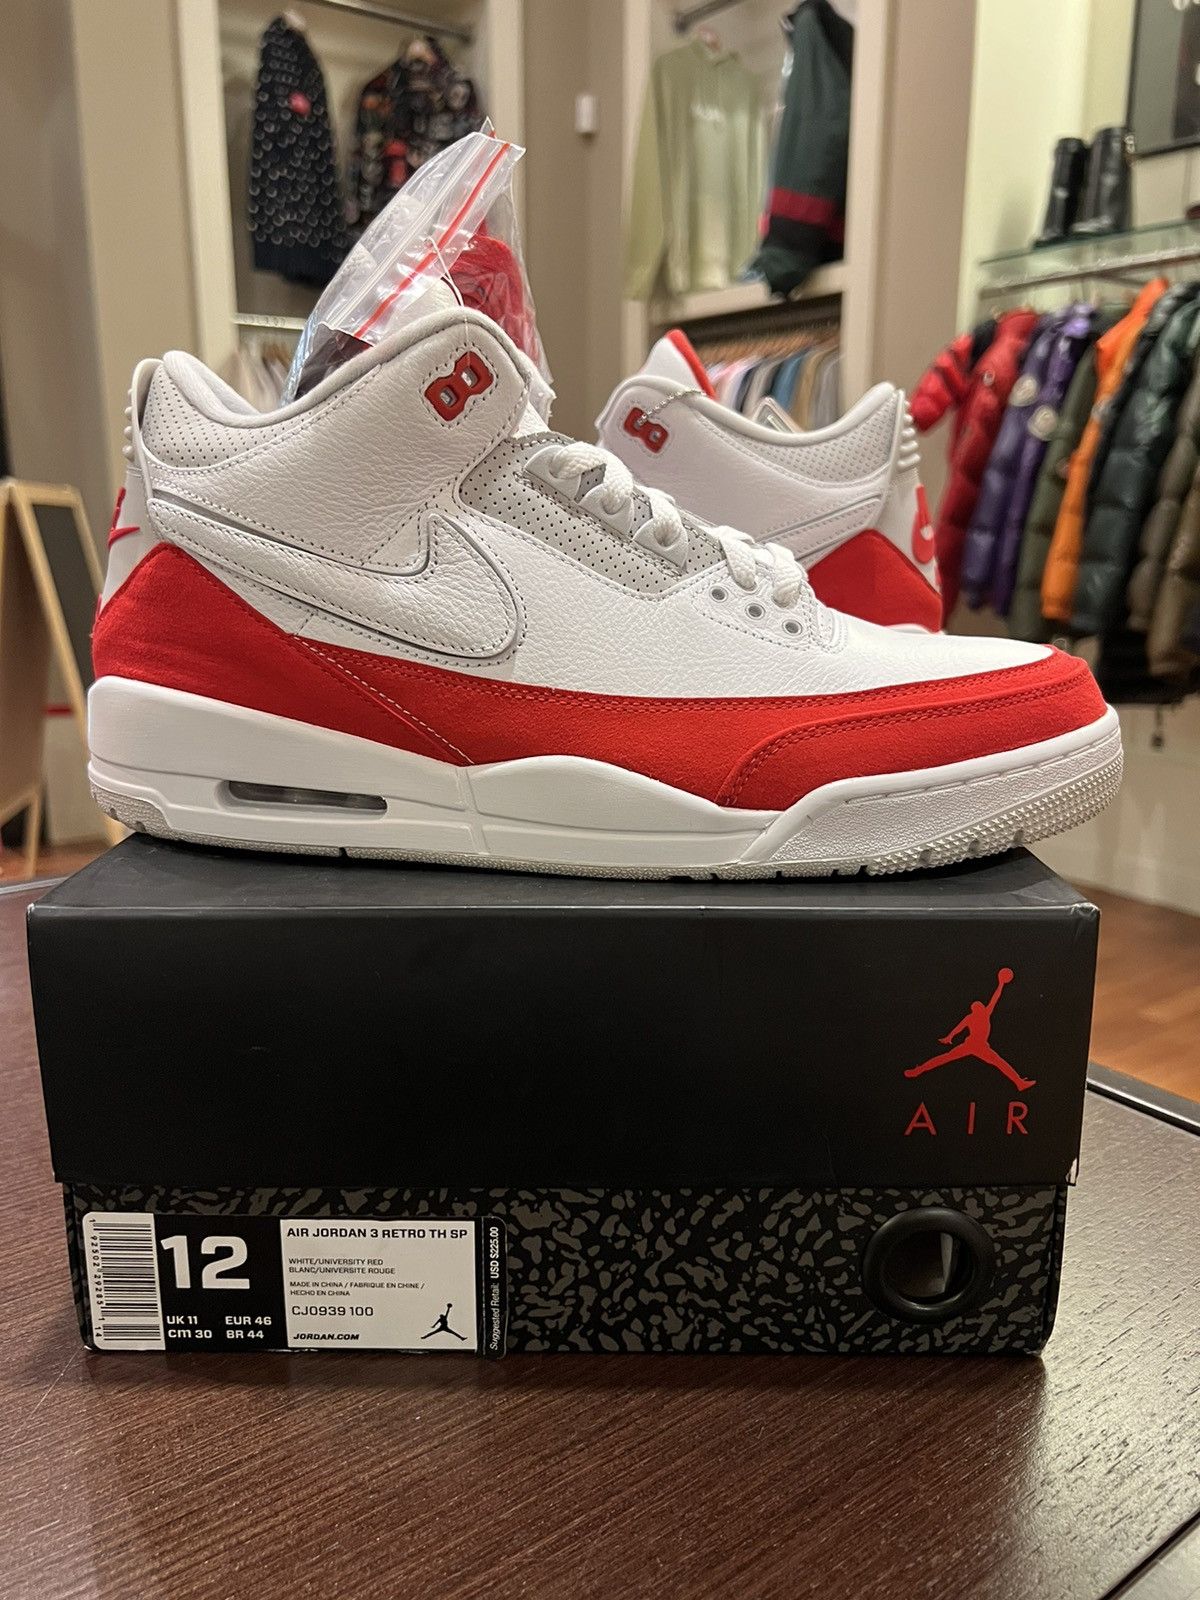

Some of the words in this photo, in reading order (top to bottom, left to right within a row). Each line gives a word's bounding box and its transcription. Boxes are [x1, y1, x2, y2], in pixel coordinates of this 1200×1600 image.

[904, 1101, 1029, 1136] AIR
[287, 1227, 310, 1238] AIR
[312, 1227, 367, 1238] JORDAN
[370, 1228, 379, 1238] 3
[382, 1228, 426, 1239] RETRO
[429, 1228, 447, 1239] TH
[450, 1229, 468, 1239] SP
[490, 1226, 499, 1259] $225.00
[91, 1235, 100, 1267] 92502
[160, 1235, 250, 1290] 12
[288, 1257, 366, 1266] WHITE/UNIVERSITY
[367, 1258, 384, 1266] RED
[288, 1266, 366, 1275] BLANC/UNIVERSITE
[367, 1267, 396, 1275] ROUGE
[490, 1260, 500, 1279] USD
[94, 1274, 104, 1306] 29285
[349, 1281, 385, 1289] FABRIQUE
[397, 1282, 419, 1290] CHINE
[291, 1305, 346, 1316] CJ0939
[349, 1306, 374, 1317] 100
[166, 1315, 185, 1325] UK
[187, 1315, 198, 1325] 11
[225, 1316, 252, 1325] EUR
[254, 1316, 272, 1325] 46
[95, 1326, 102, 1337] 14
[195, 1329, 213, 1339] 30
[226, 1329, 244, 1339] BR
[247, 1330, 264, 1339] 44
[490, 1307, 501, 1351] Suggested
[293, 1333, 360, 1341] JORDAN.COM
